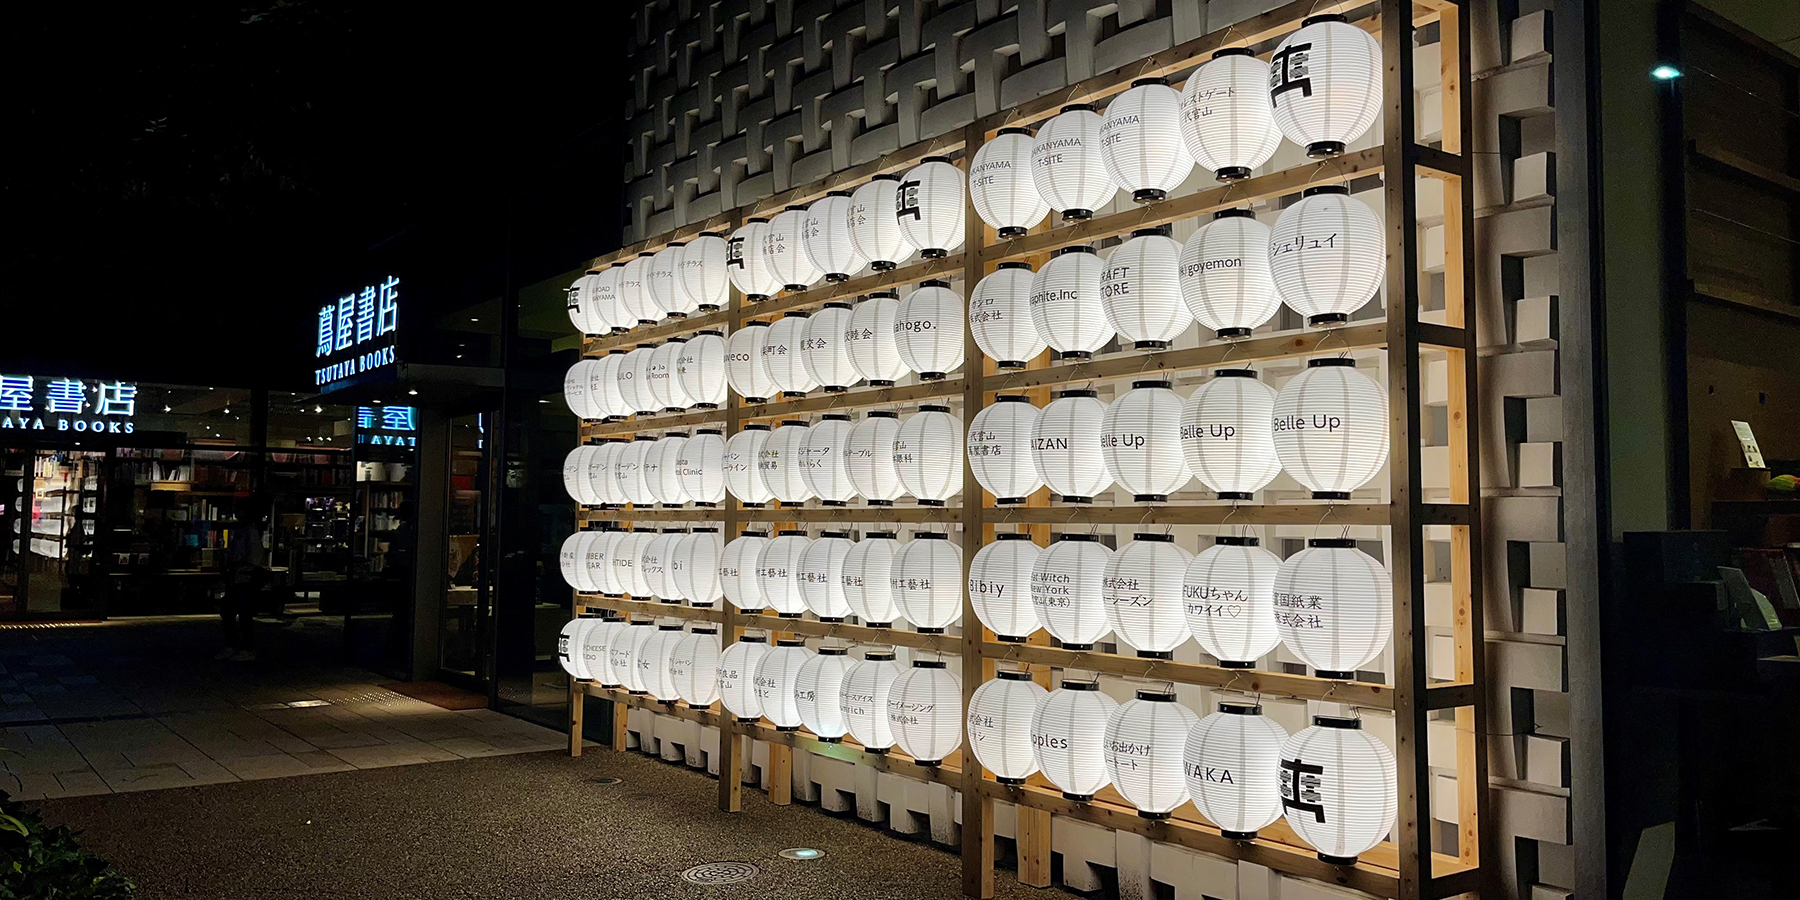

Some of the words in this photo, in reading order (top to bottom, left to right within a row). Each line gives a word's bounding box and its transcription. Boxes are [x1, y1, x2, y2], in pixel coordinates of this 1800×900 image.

[1038, 154, 1063, 167] T-SITE
[316, 275, 400, 358] 蔦屋書店
[315, 358, 356, 385] TSUTAYA
[359, 345, 395, 373] BOOKS
[57, 418, 135, 434] BOOKS
[1274, 415, 1306, 432] Belle
[1313, 414, 1341, 432] Up
[1210, 424, 1235, 441] Up
[1123, 433, 1145, 450] Up
[1040, 573, 1070, 583] Witch
[970, 579, 1004, 598] Bibiy
[1045, 585, 1070, 595] York
